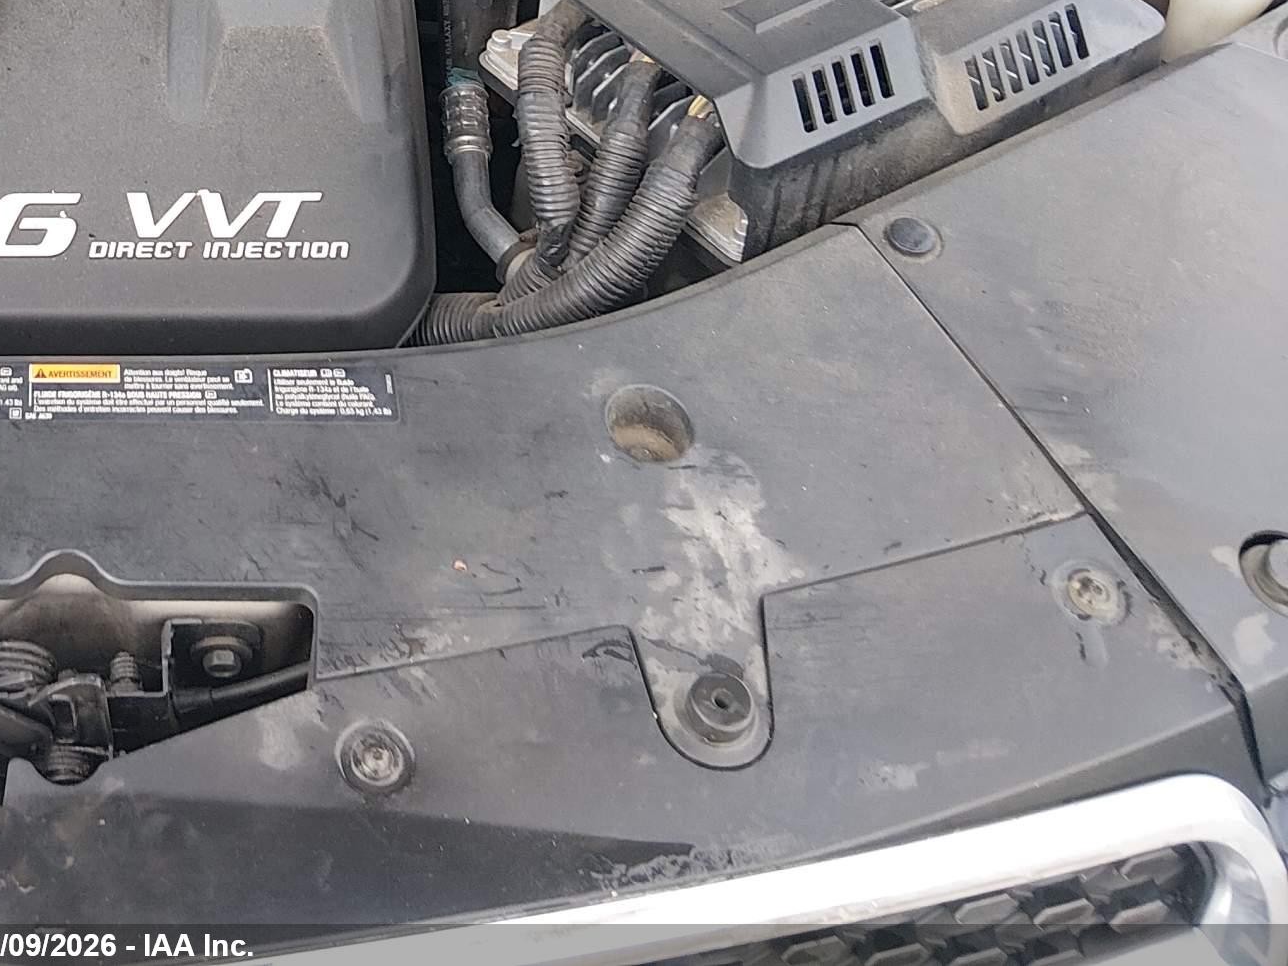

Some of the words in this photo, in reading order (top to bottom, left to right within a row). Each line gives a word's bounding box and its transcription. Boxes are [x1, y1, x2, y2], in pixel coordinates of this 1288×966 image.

[126, 190, 323, 238] VVT
[88, 241, 192, 259] DIRECT
[202, 241, 349, 259] INJECTION
[48, 370, 112, 379] AVERTISSEMENT
